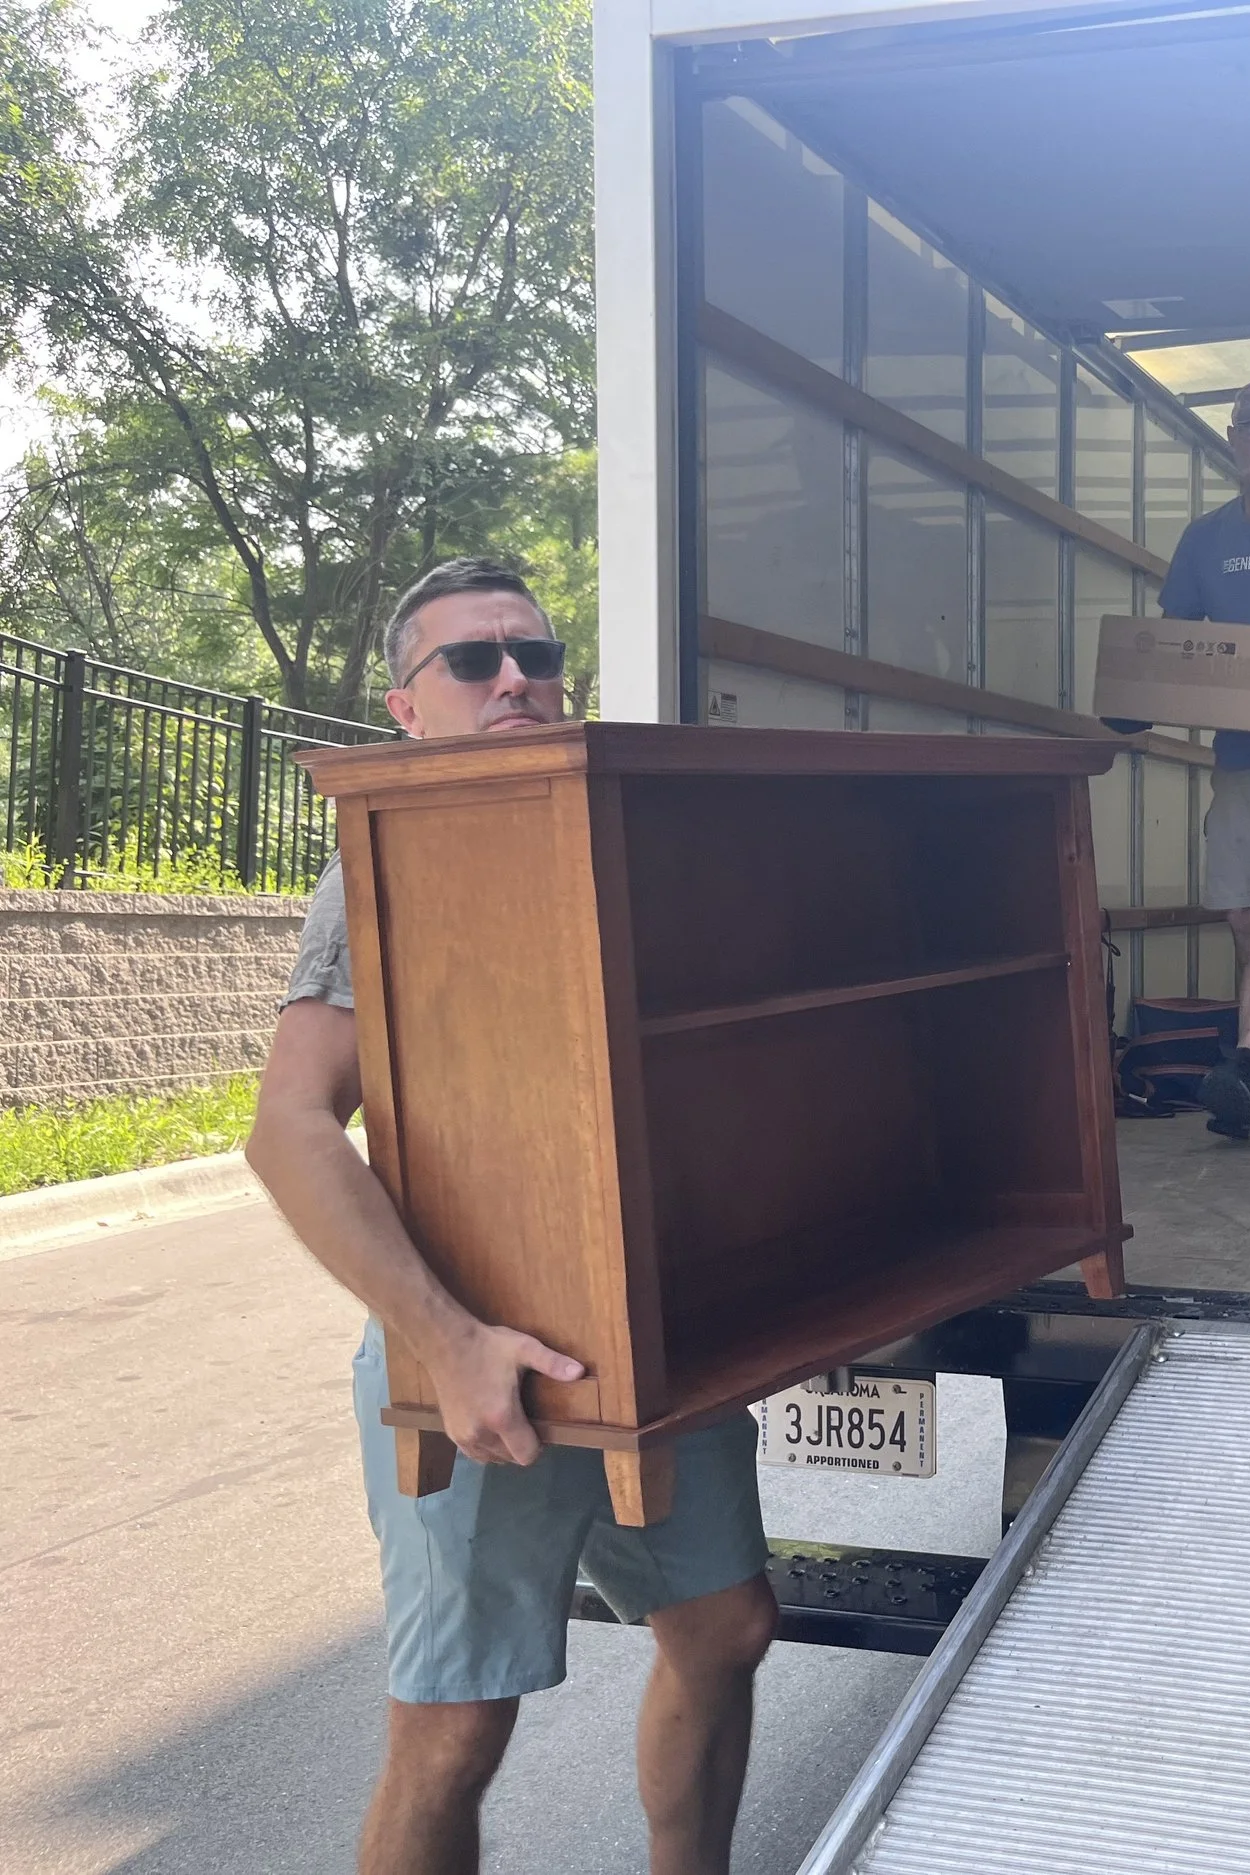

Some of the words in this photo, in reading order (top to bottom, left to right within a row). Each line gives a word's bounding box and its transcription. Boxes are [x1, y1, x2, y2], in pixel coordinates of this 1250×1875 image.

[785, 1402, 907, 1453] 3JR854
[918, 1392, 926, 1468] PERMANENT
[806, 1454, 880, 1470] APPORTIONED
